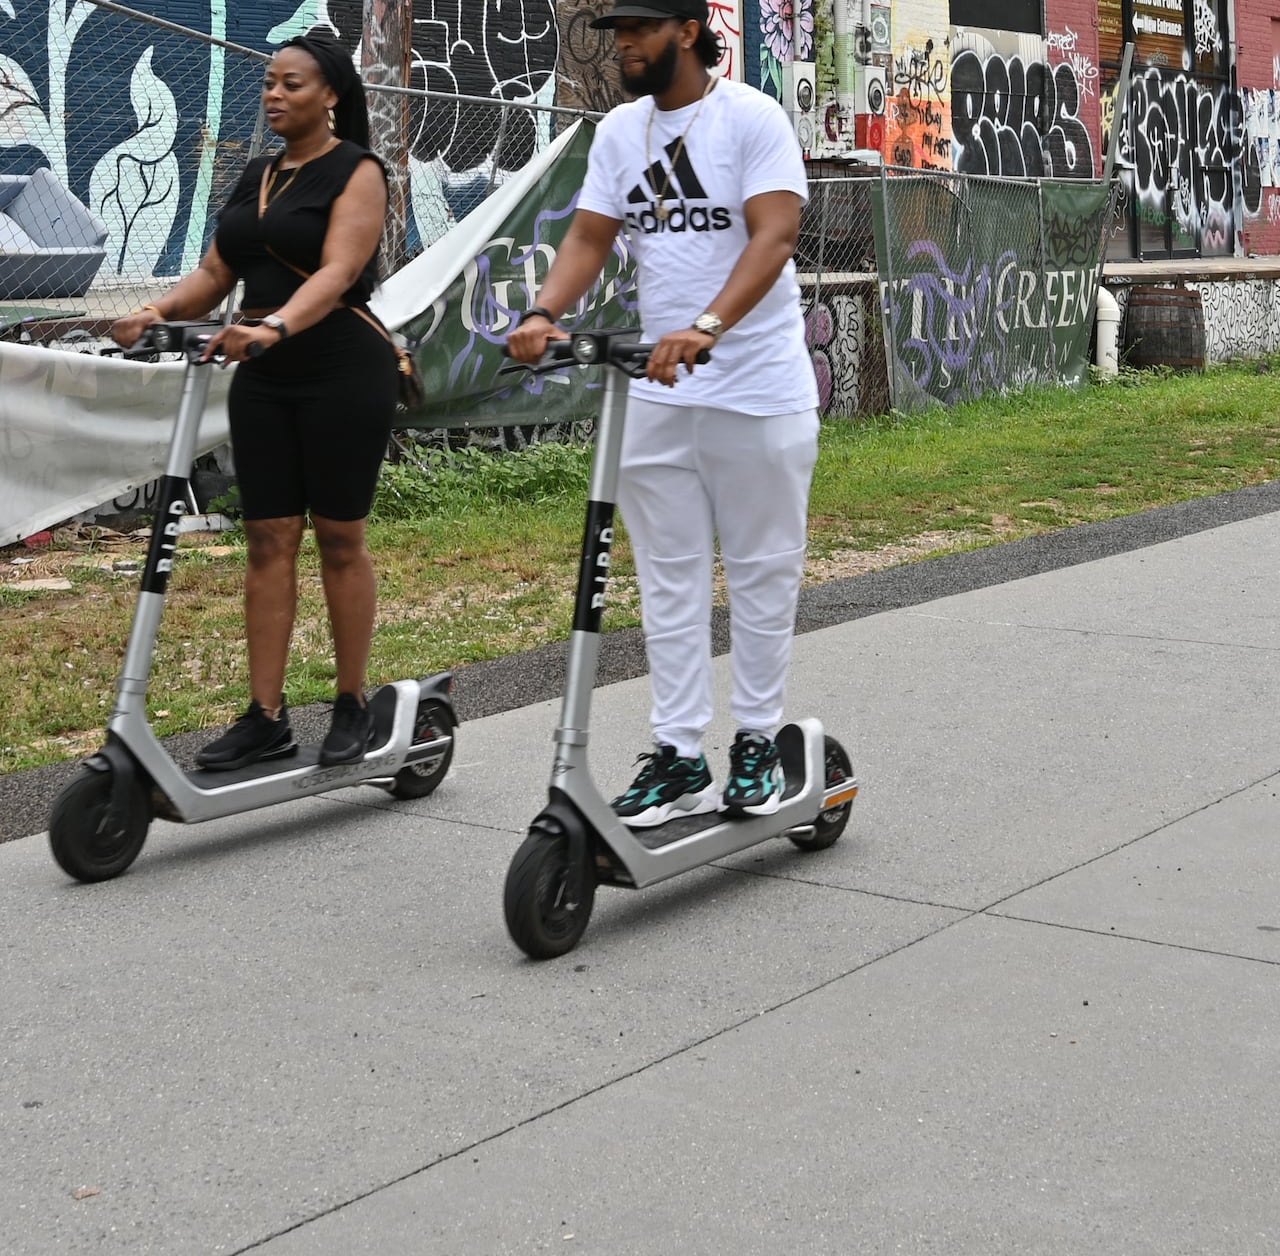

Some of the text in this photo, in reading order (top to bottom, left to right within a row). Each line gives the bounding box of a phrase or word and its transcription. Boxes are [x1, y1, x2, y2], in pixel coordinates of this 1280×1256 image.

[1157, 18, 1182, 36] Entrance
[156, 499, 187, 573] BIRD
[591, 527, 615, 609] BIRD
